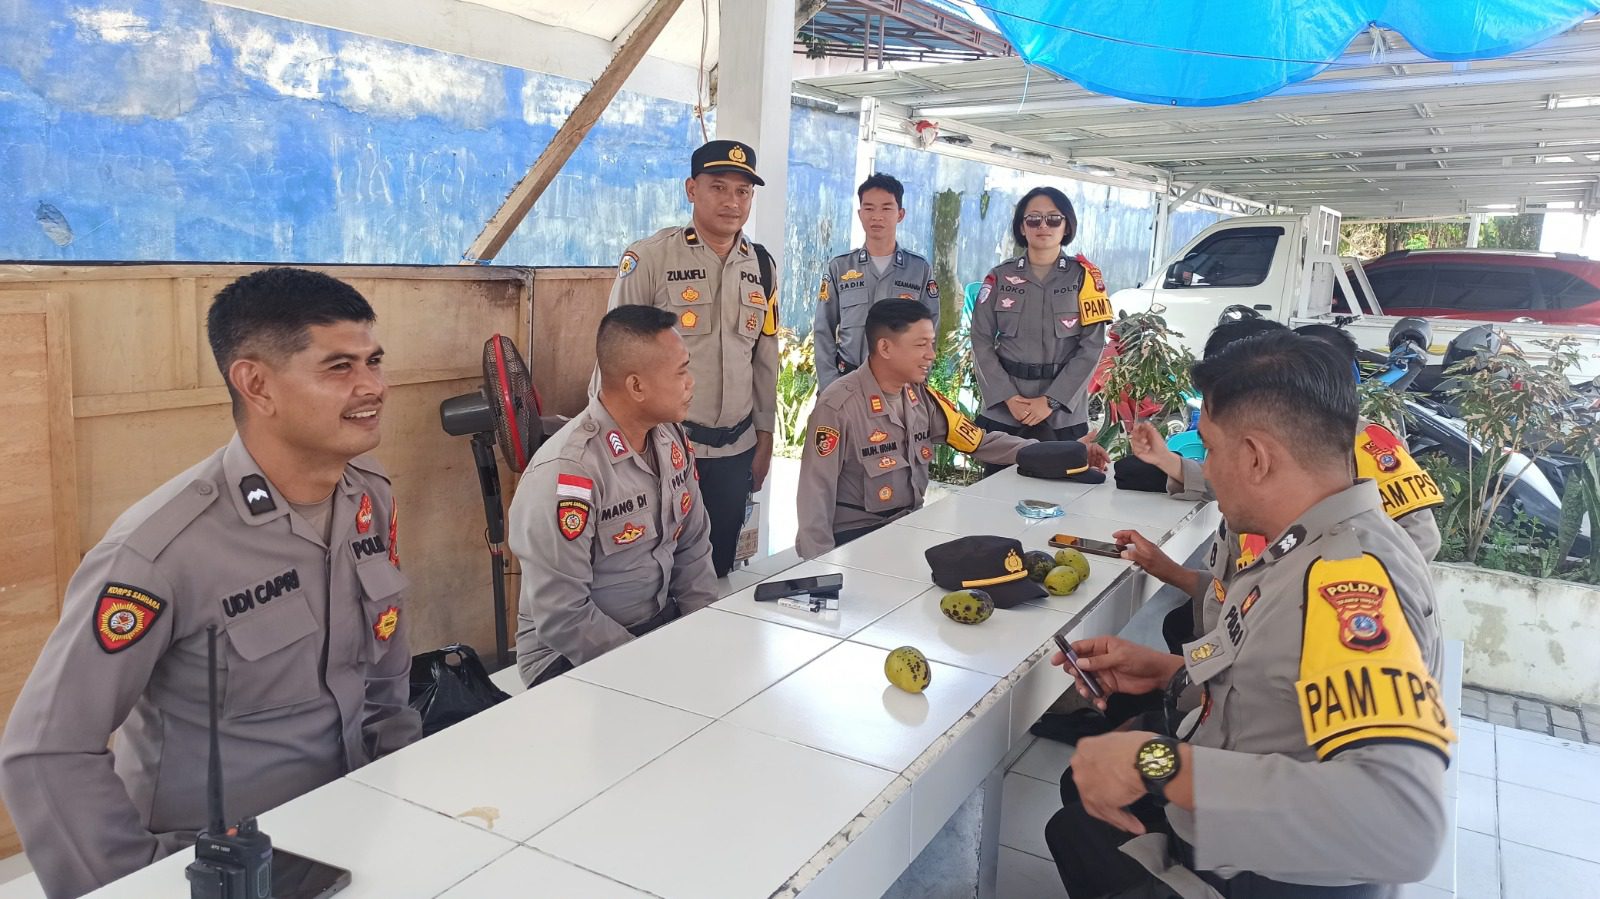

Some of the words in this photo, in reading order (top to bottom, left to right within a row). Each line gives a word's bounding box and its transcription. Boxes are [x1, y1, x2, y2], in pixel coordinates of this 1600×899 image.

[667, 269, 706, 281] ZULKIFLI
[741, 271, 766, 285] POL
[840, 281, 865, 290] SADIK
[1084, 298, 1107, 318] PAM
[1379, 481, 1409, 512] AM
[1403, 474, 1438, 500] TPS
[637, 494, 648, 509] DI
[107, 586, 132, 597] KORPS
[222, 594, 254, 618] UDI
[255, 569, 300, 604] CAPRI
[1327, 582, 1379, 596] POLDA
[1305, 666, 1378, 733] PAM
[1381, 667, 1447, 729] TPS
